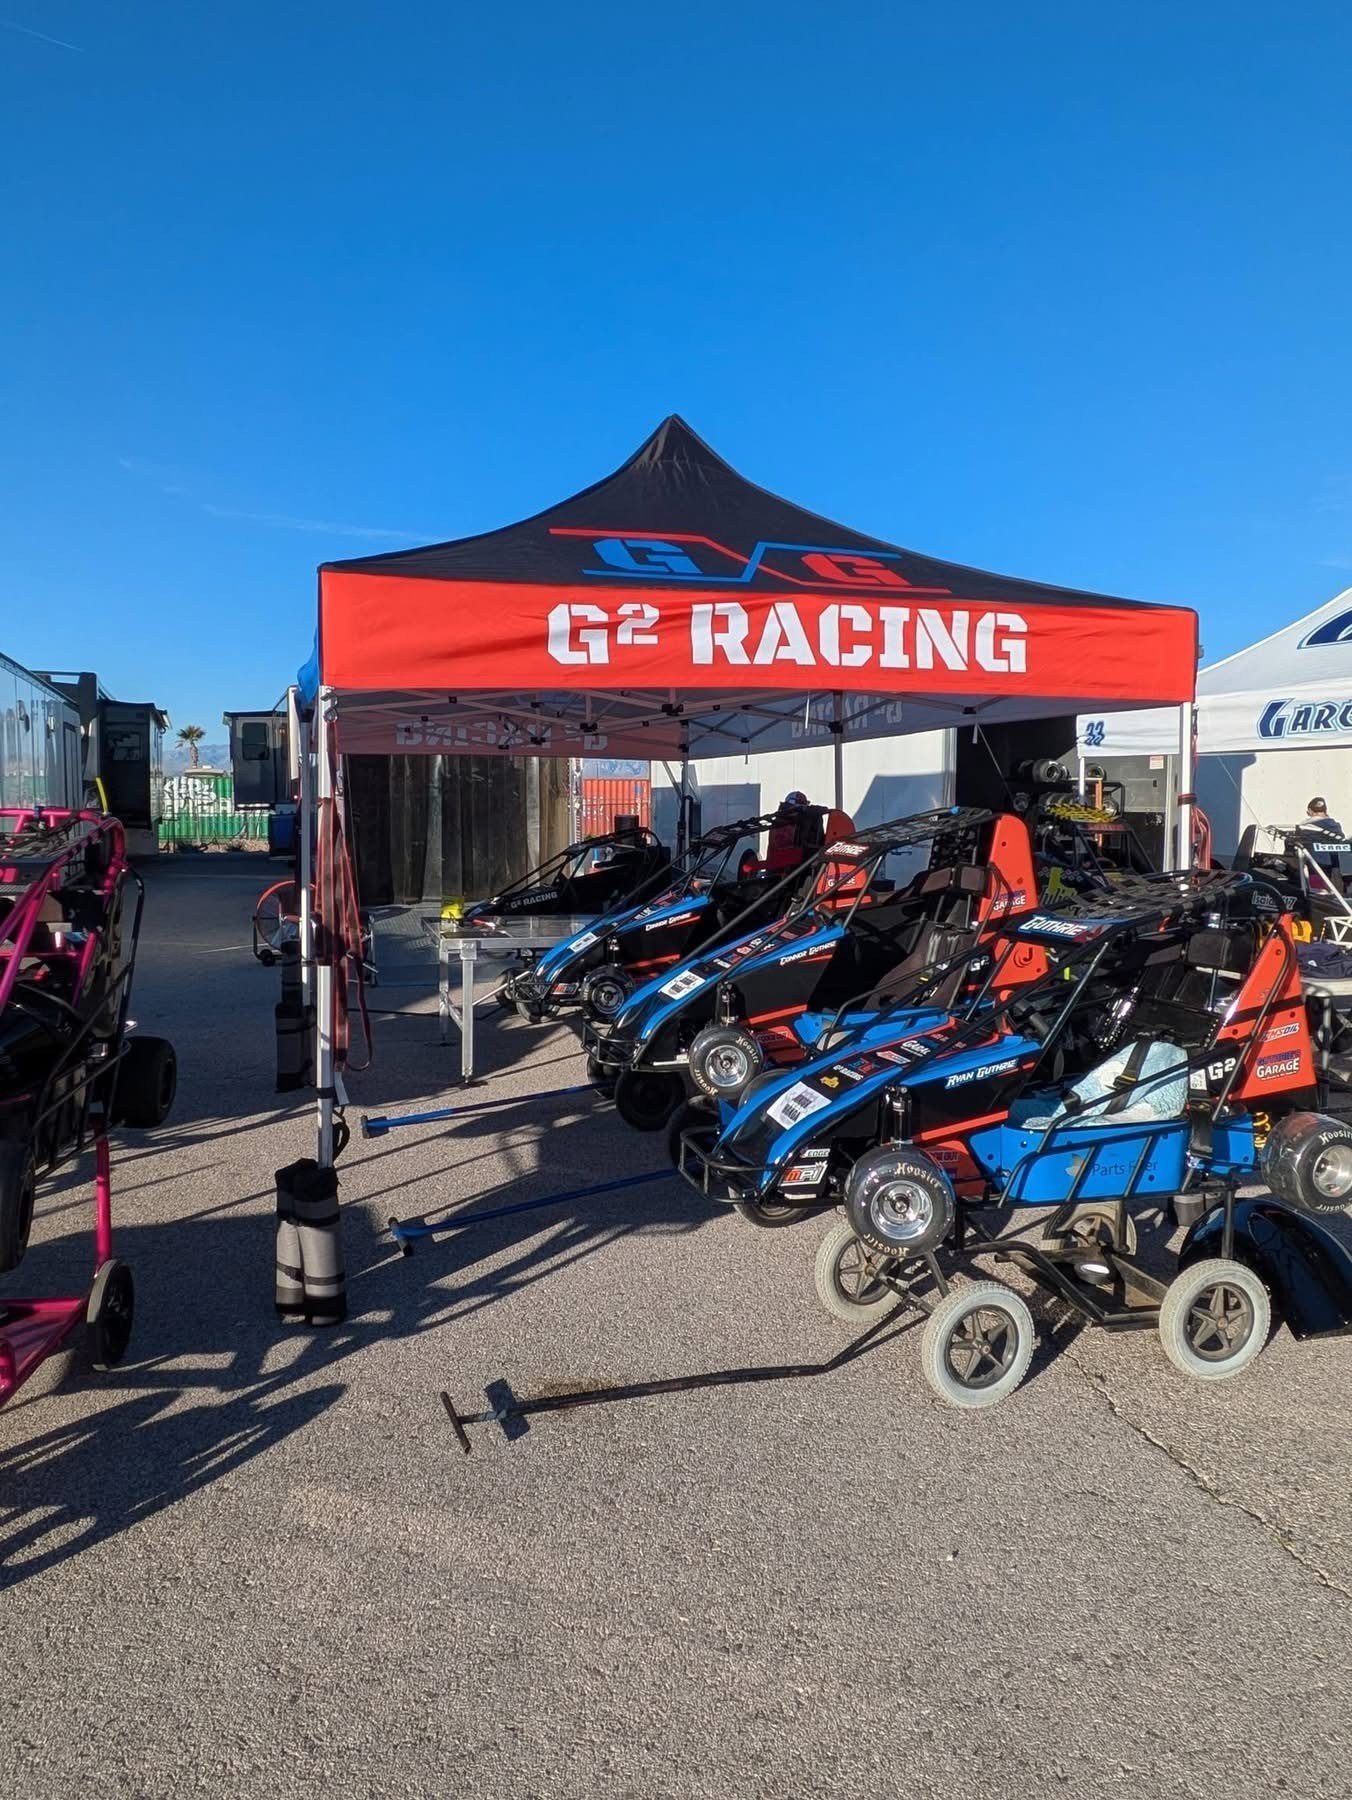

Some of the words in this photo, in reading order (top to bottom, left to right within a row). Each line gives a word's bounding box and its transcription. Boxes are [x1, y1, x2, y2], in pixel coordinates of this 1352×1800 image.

[690, 602, 1029, 674] RACING
[523, 891, 559, 906] RACING
[1019, 916, 1088, 936] GUTHRIE
[780, 950, 808, 967] CONNOR
[735, 1036, 760, 1064] Hoosier
[945, 1071, 975, 1090] RYAN
[976, 1058, 1018, 1079] GUTHRIE
[1257, 1058, 1300, 1078] GARAGE
[894, 1162, 942, 1188] Hoosier
[1092, 1160, 1125, 1177] Parts
[863, 1233, 910, 1257] Hoosier
